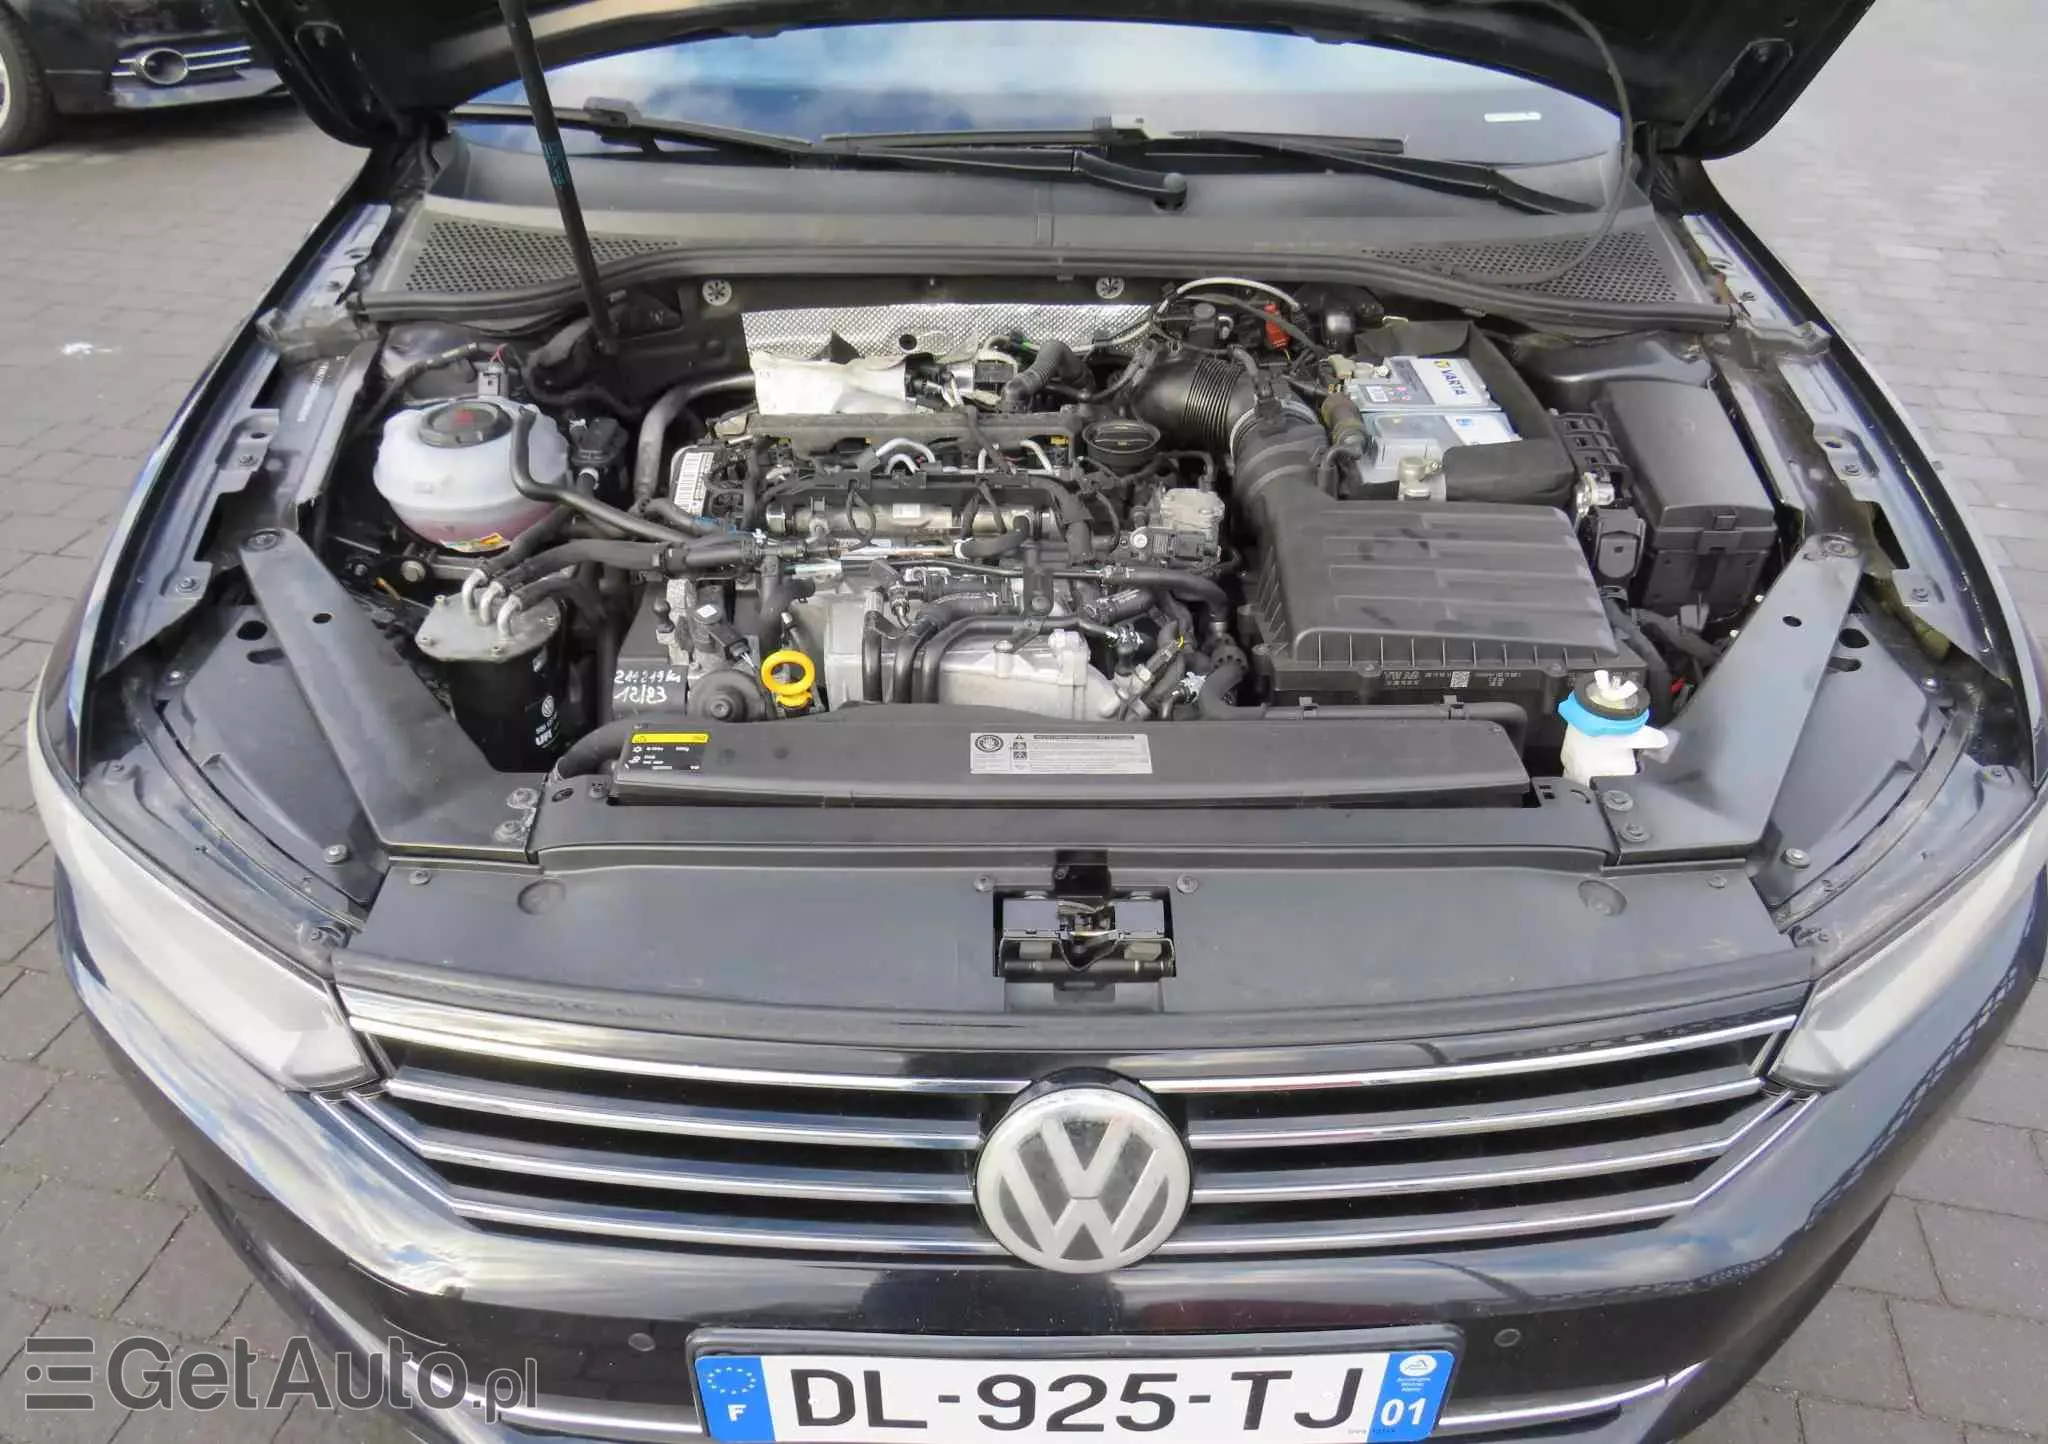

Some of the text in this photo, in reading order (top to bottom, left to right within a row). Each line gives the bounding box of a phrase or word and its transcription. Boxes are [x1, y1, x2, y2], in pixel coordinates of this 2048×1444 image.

[1441, 369, 1468, 395] VARTA
[613, 684, 667, 704] 12/23
[790, 1367, 1364, 1432] DL-925-TJ
[1380, 1396, 1427, 1426] 01
[727, 1404, 747, 1422] F
